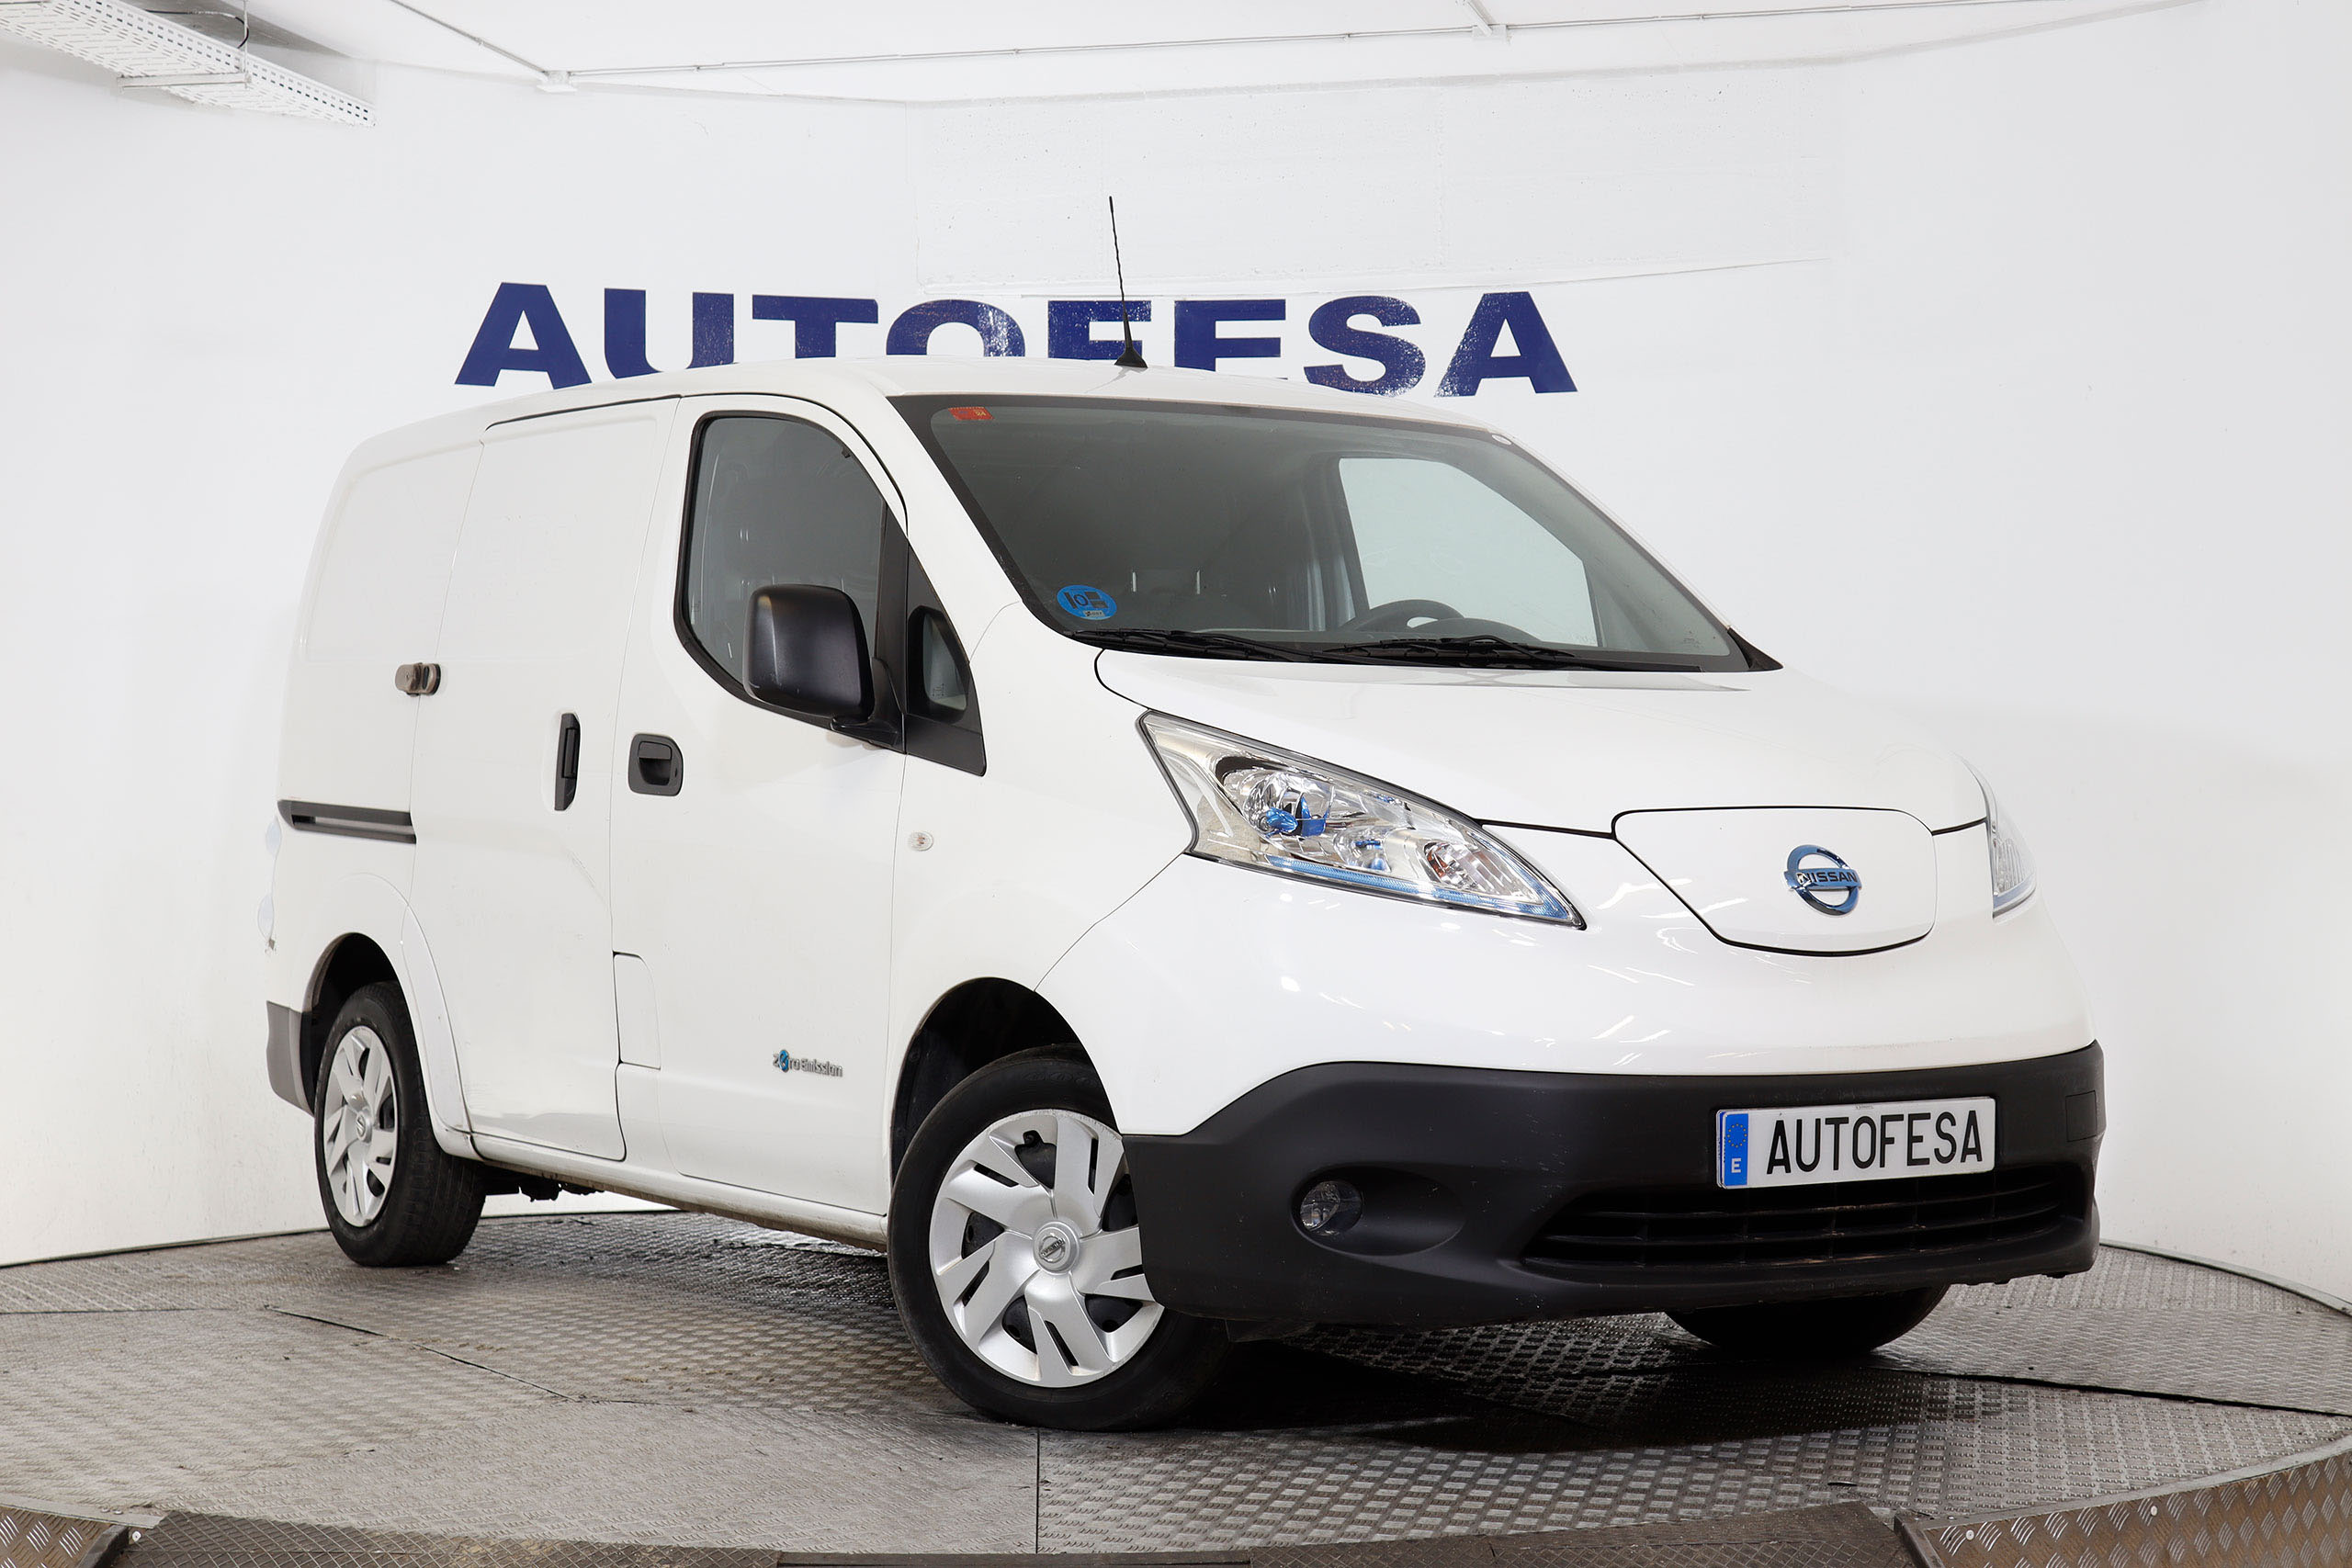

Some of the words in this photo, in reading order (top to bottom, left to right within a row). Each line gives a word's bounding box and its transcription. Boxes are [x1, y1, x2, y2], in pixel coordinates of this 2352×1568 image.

[455, 282, 1577, 398] AUTOFESA
[1797, 871, 1858, 884] NISSAN
[1766, 1110, 1983, 1175] AUTOFESA
[1731, 1157, 1741, 1173] E
